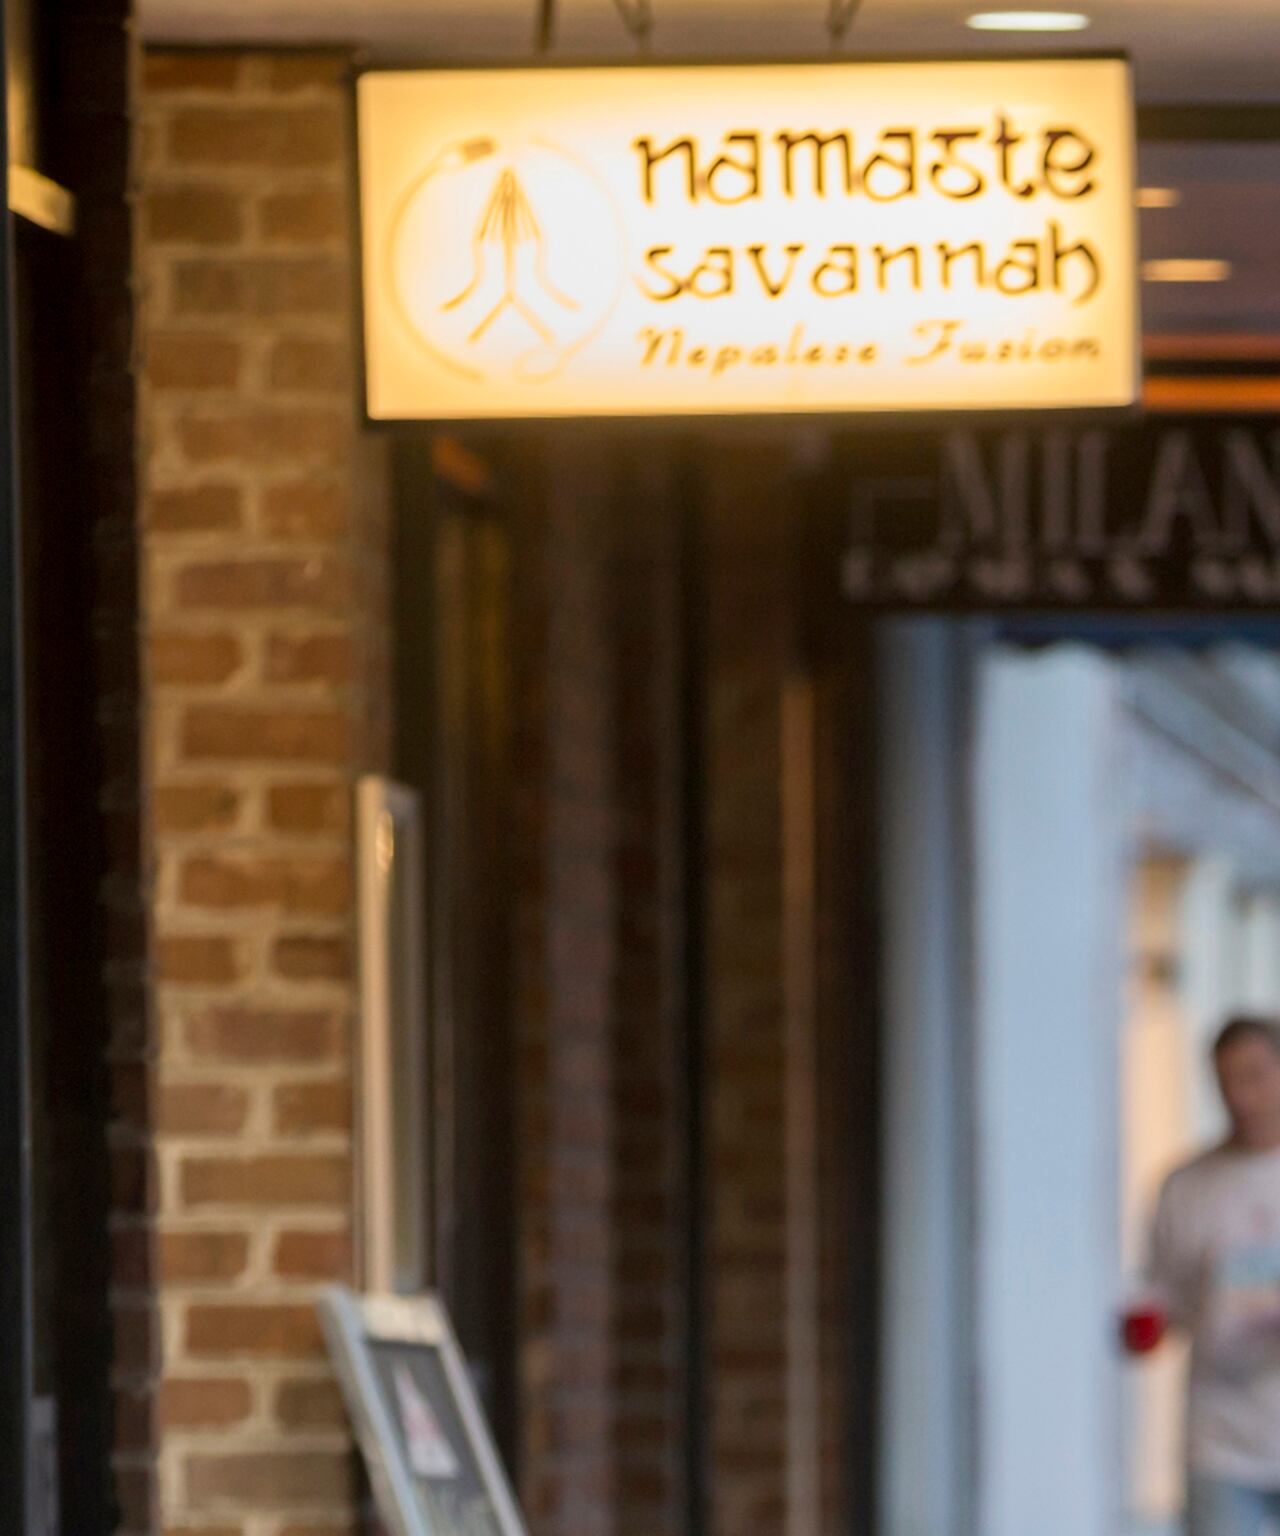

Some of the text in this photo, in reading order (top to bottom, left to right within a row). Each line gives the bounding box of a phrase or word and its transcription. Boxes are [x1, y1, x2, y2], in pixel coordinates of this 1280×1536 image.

[634, 109, 1097, 204] namaste
[635, 218, 1103, 305] savannah
[638, 318, 1101, 377] Nepalese Fusion
